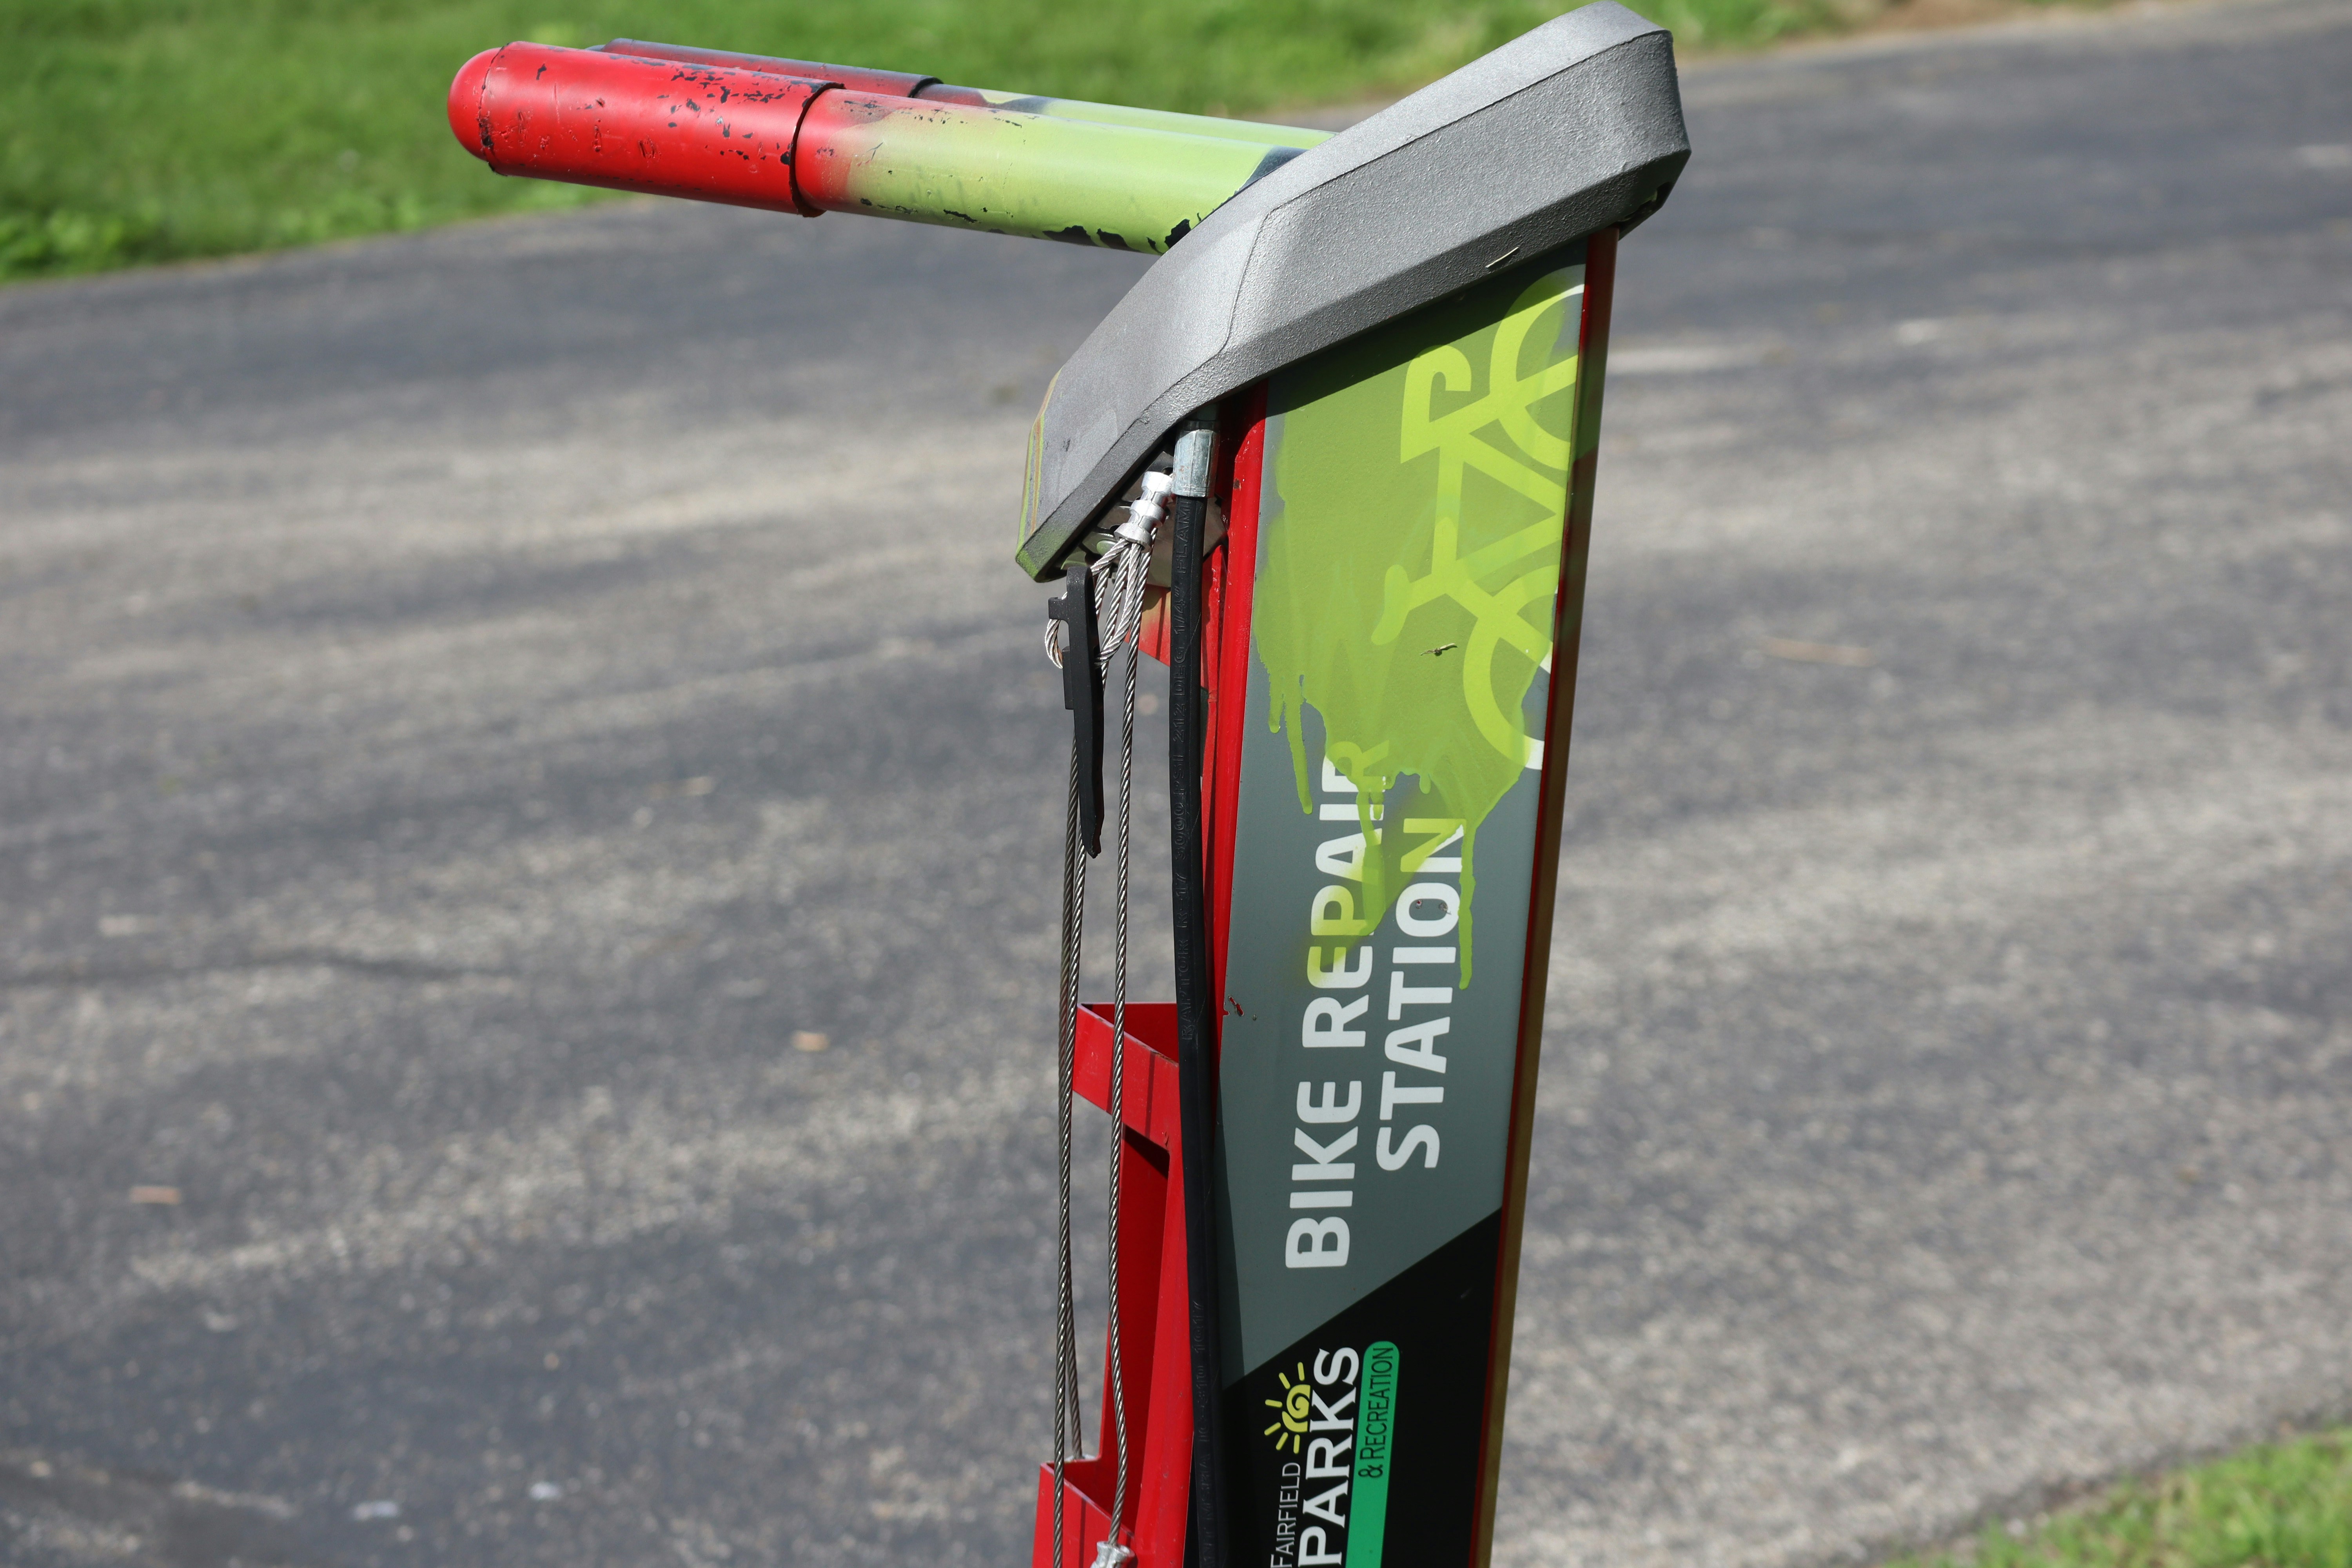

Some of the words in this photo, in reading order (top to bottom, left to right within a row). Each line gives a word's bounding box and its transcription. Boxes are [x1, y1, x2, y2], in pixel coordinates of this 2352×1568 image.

[1173, 647, 1186, 697] DEG
[1172, 703, 1185, 743] 212
[1172, 755, 1185, 796] PSI
[1173, 802, 1186, 861] 3000
[1175, 872, 1188, 928] R-17
[1302, 740, 1390, 1047] REPAIR
[1177, 940, 1194, 1040] RAPTOR
[1376, 818, 1467, 1171] STATION
[1285, 1080, 1362, 1269] BIKE
[1360, 1347, 1394, 1459] RECREATION
[1298, 1347, 1359, 1567] PARKS
[1358, 1464, 1383, 1478] &
[1270, 1463, 1300, 1568] FAIRFIELD
